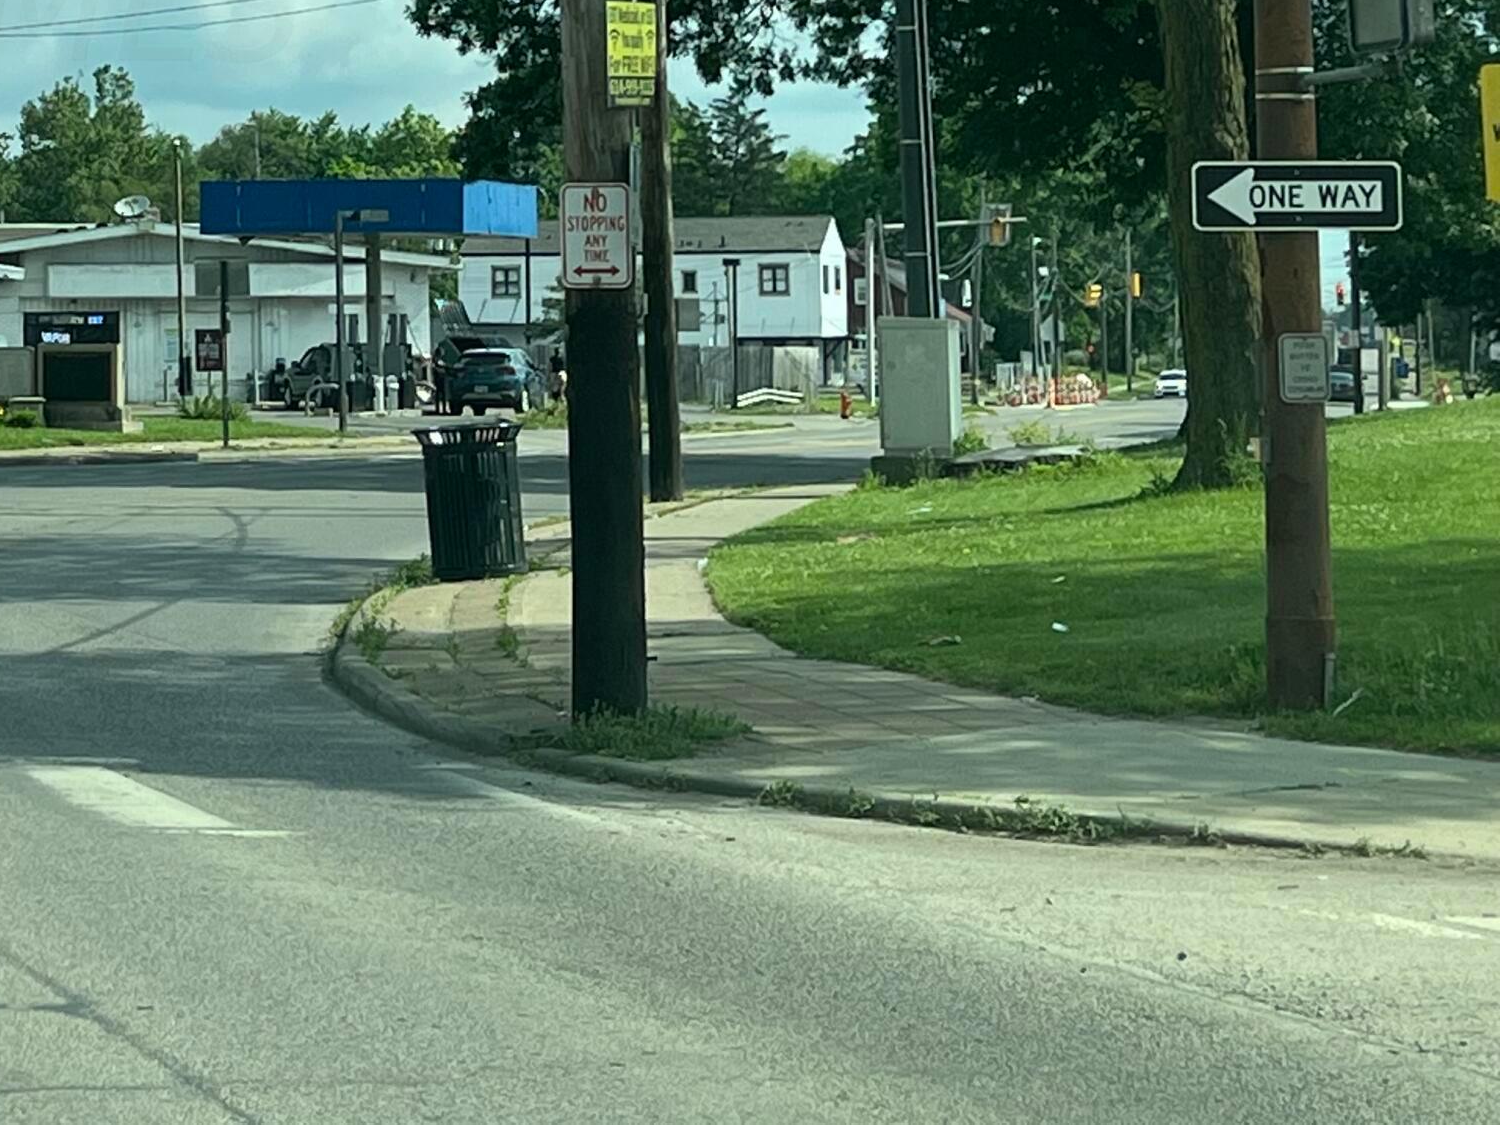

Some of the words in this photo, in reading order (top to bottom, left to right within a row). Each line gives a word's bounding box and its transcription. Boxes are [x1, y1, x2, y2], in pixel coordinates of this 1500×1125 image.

[584, 193, 607, 212] NO
[1249, 184, 1304, 209] ONE
[1318, 184, 1377, 209] WAY
[567, 215, 625, 232] STOPPING
[584, 234, 608, 248] ANY
[584, 249, 610, 263] TIME
